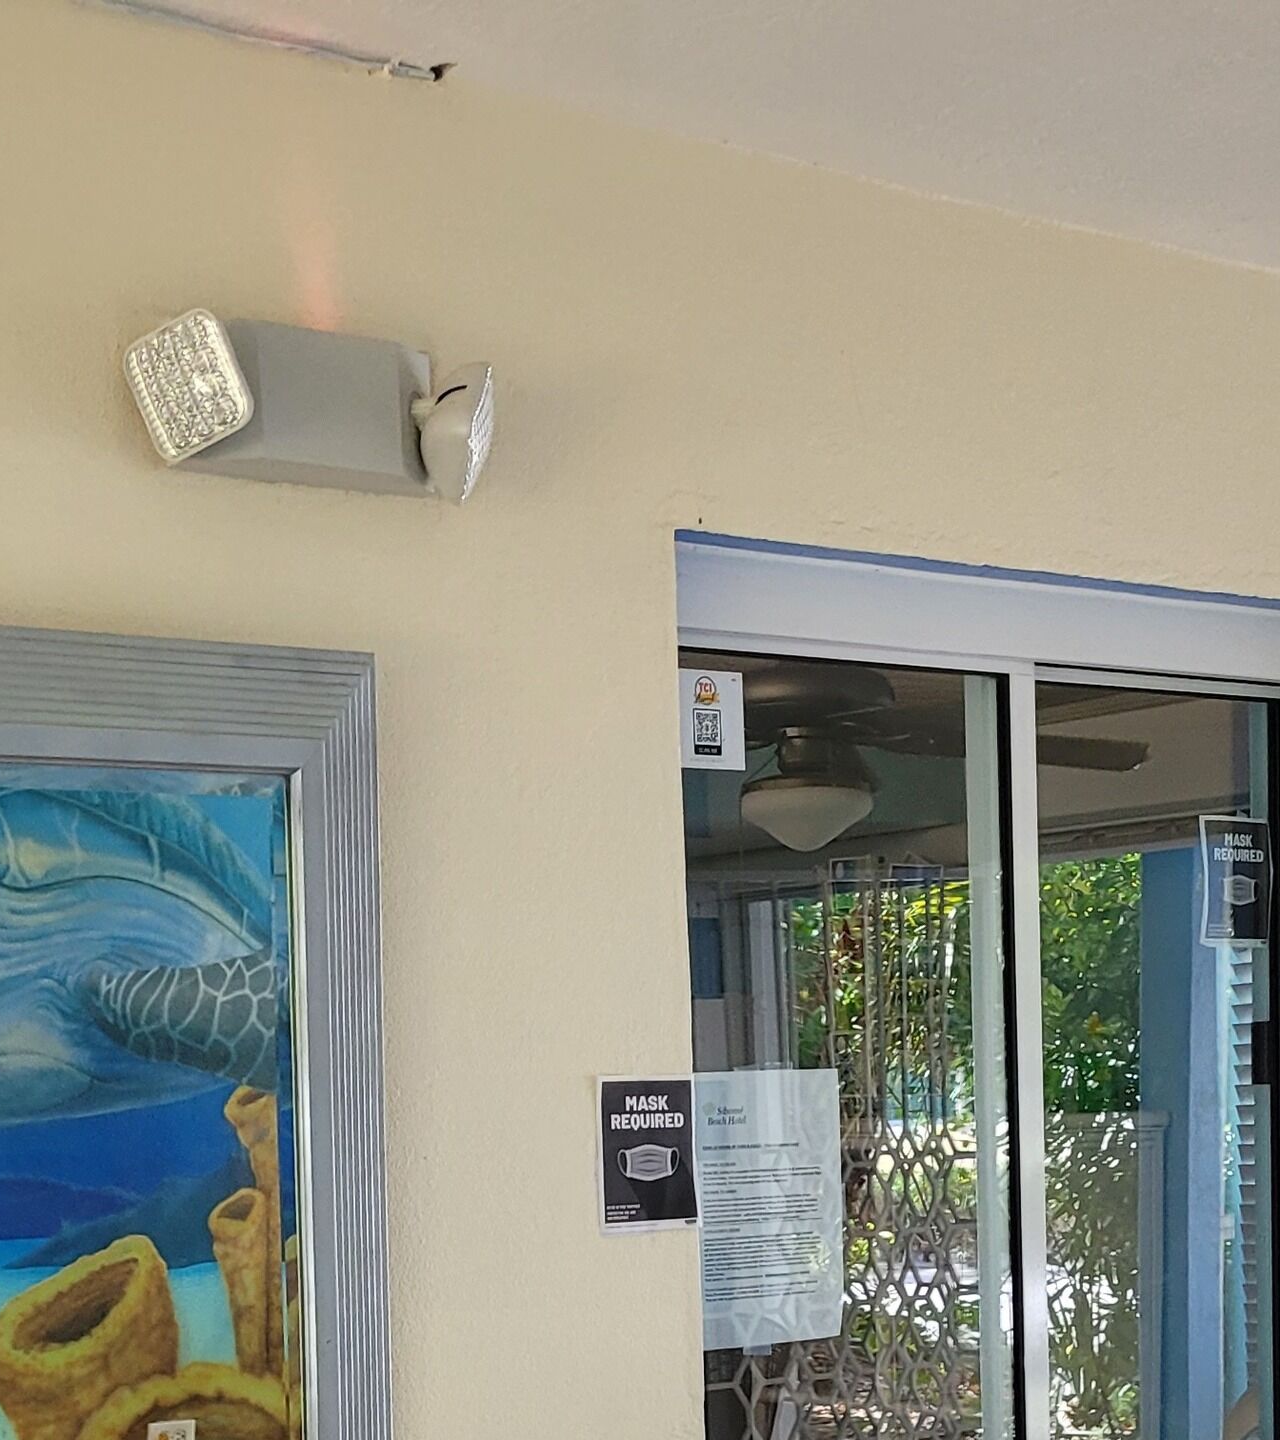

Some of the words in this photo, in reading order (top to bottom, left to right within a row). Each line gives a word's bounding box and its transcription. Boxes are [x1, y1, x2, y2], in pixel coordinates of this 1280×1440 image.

[699, 682, 712, 693] TCI
[1224, 832, 1253, 848] MASK
[1214, 847, 1264, 863] REQUIRED
[625, 1095, 669, 1112] MASK
[610, 1112, 684, 1131] REQUIRED
